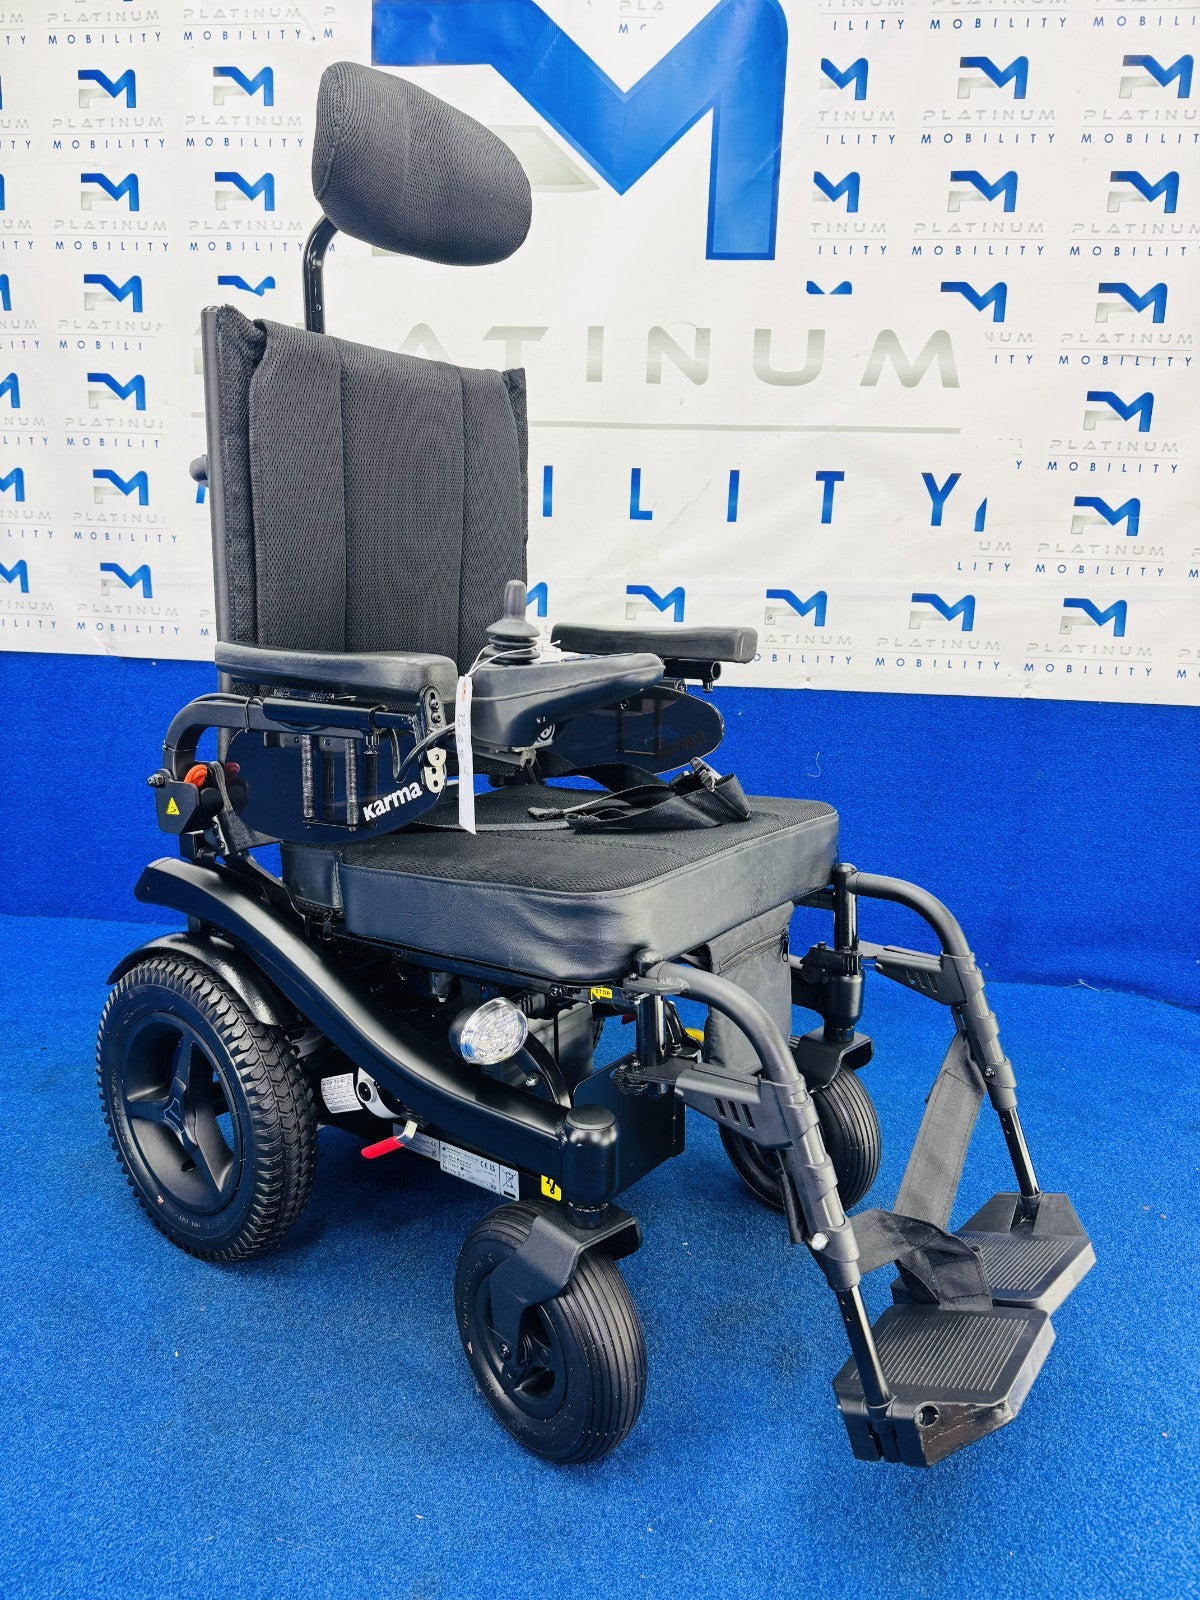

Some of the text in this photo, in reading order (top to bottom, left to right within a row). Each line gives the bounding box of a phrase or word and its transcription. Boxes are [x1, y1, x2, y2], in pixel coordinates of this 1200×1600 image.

[47, 10, 160, 23] PLATINUM
[184, 8, 300, 18] PLATINUM
[930, 17, 1066, 29] MOBILITY
[49, 32, 160, 44] MOBILITY
[184, 30, 301, 40] MOBILITY
[186, 115, 302, 126] PLATINUM
[923, 110, 1055, 120] PLATINUM
[52, 117, 162, 128] PLATINUM
[53, 139, 164, 149] MOBILITY
[186, 137, 303, 147] MOBILITY
[921, 133, 1055, 144] MOBILITY
[55, 220, 166, 230] PLATINUM
[189, 220, 302, 231] PLATINUM
[914, 223, 1044, 233] PLATINUM
[56, 241, 168, 251] MOBILITY
[190, 242, 304, 251] MOBILITY
[912, 246, 1044, 255] MOBILITY
[1061, 333, 1192, 344] PLATINUM
[398, 323, 960, 388] ATINUM
[1059, 355, 1192, 366] MOBILITY
[1048, 440, 1177, 452] PLATINUM
[1047, 461, 1177, 473] MOBILITY
[542, 465, 961, 526] ILITY
[74, 532, 176, 542] MOBILITY
[1037, 543, 1164, 555] PLATINUM
[1035, 564, 1163, 576] MOBILITY
[78, 604, 177, 617] PLATINUM
[77, 622, 179, 634] MOBILITY
[764, 634, 851, 645] ATINUM
[876, 638, 1000, 651] PLATINUM
[1026, 643, 1152, 656] PLATINUM
[754, 655, 851, 664] OBILITY
[875, 658, 1000, 670] MOBILITY
[1024, 663, 1152, 676] MOBILITY
[595, 988, 611, 996] STOP
